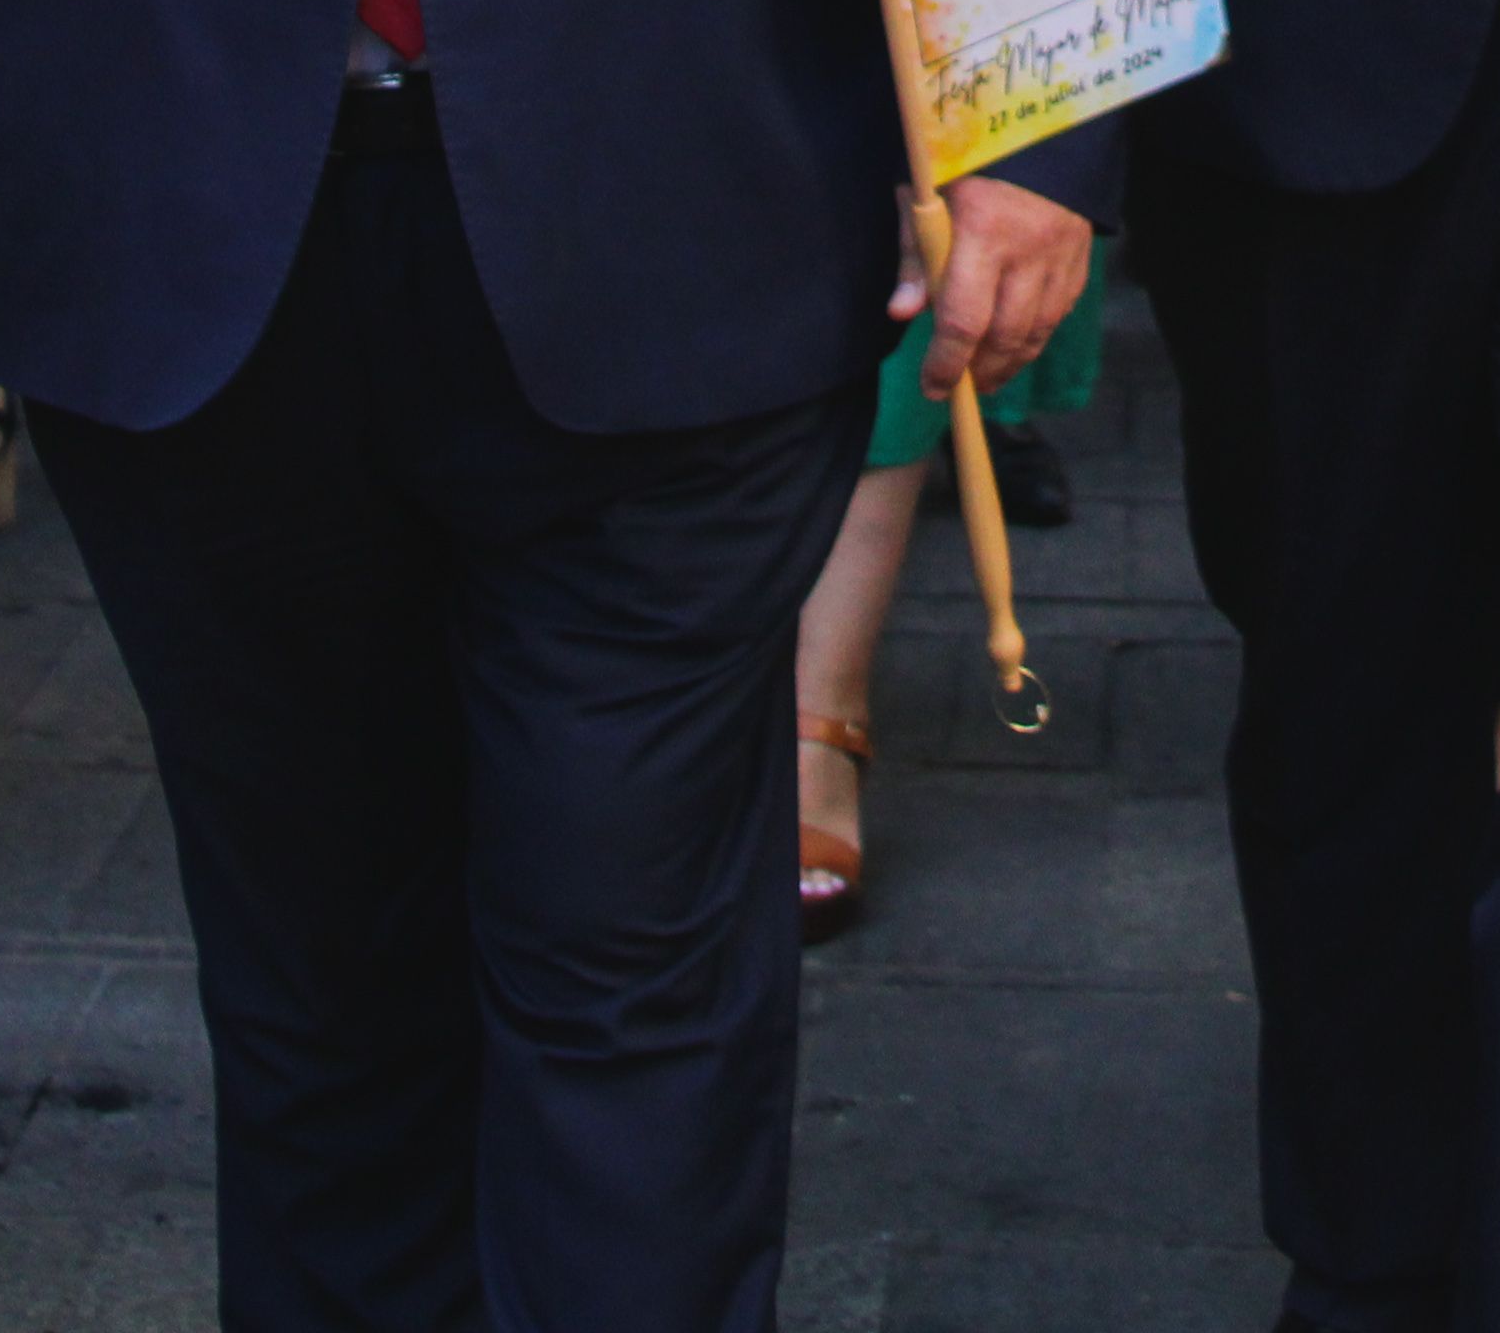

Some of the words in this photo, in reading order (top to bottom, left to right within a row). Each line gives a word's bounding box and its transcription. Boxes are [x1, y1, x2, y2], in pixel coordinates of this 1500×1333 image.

[924, 55, 995, 123] Festa
[996, 29, 1081, 94] Major
[1015, 101, 1037, 119] de
[1093, 66, 1115, 87] de
[1122, 45, 1164, 74] 2024
